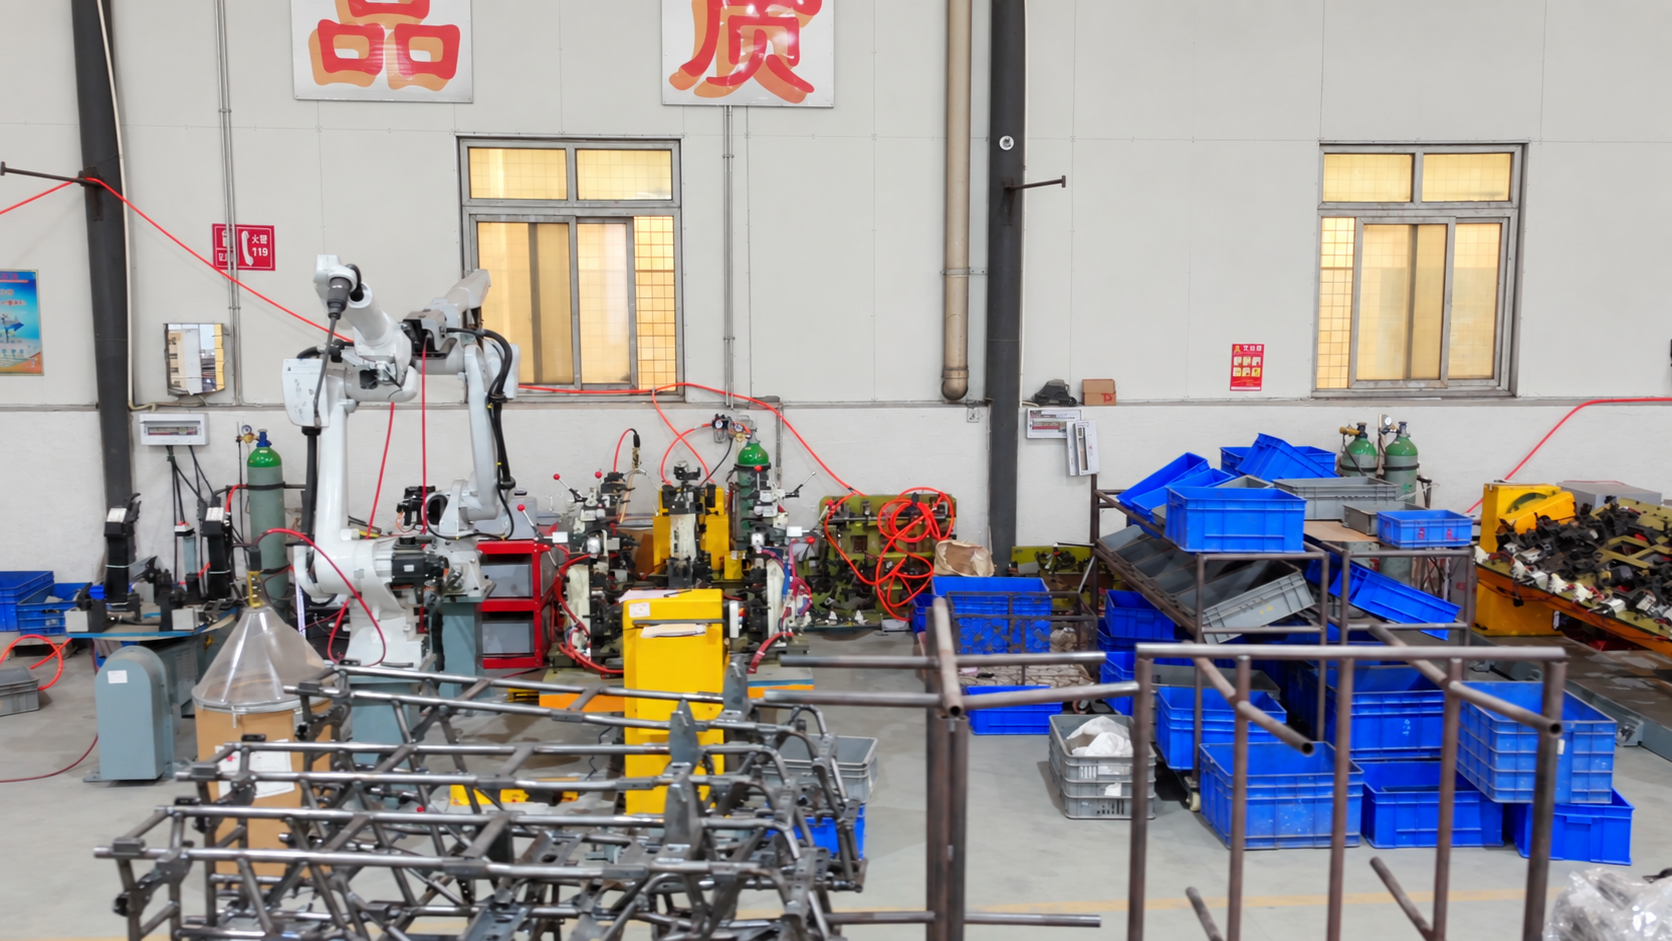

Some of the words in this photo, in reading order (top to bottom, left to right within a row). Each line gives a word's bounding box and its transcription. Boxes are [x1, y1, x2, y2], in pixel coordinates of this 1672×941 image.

[308, 0, 460, 91] 品
[669, 0, 822, 103] 质
[252, 247, 268, 257] 119
